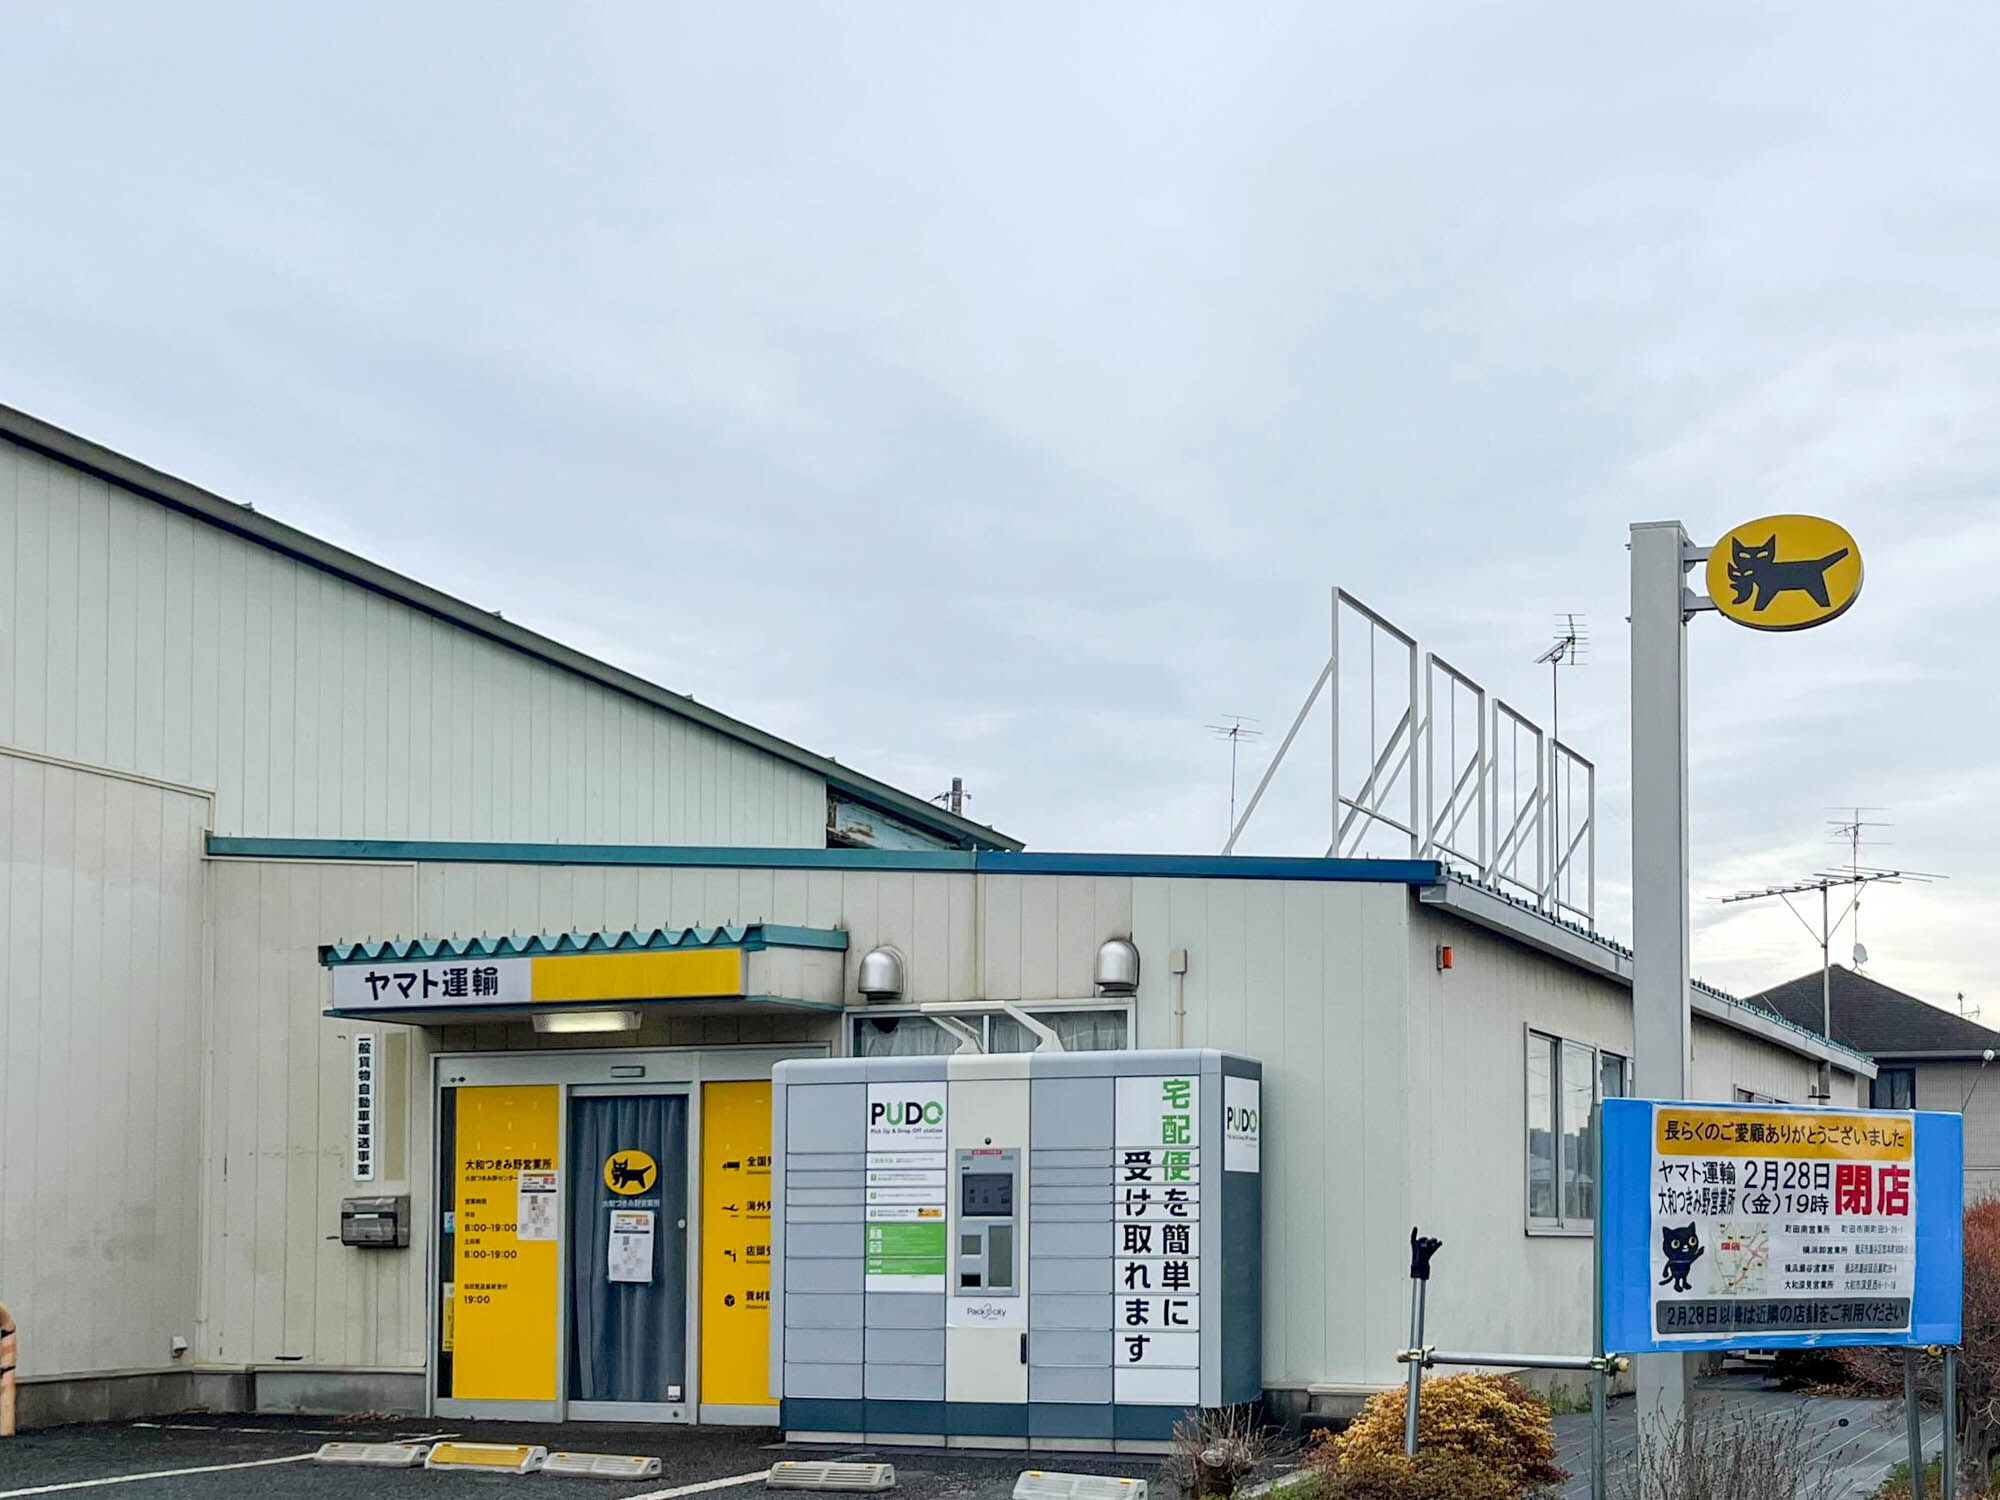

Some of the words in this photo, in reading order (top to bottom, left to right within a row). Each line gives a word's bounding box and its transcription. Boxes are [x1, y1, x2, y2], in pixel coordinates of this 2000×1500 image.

[364, 966, 499, 1001] ヤマト運輸
[357, 1037, 372, 1175] 一般貨物自動車運送事業
[871, 1101, 944, 1125] PUDO
[1227, 1106, 1258, 1133] PUDO
[465, 1158, 552, 1170] 大和つきみ野営業所
[1658, 1160, 1736, 1185] ヤマト運輸
[1743, 1160, 1830, 1191] 2月28日
[1658, 1187, 1736, 1216] 大和つきみ野営業所
[1835, 1164, 1910, 1217] 閉店
[464, 1223, 518, 1232] 8:00-19:00
[464, 1250, 518, 1259] 8:00-19:00
[1123, 1151, 1152, 1362] 受け取れます
[464, 1295, 491, 1304] 19:00
